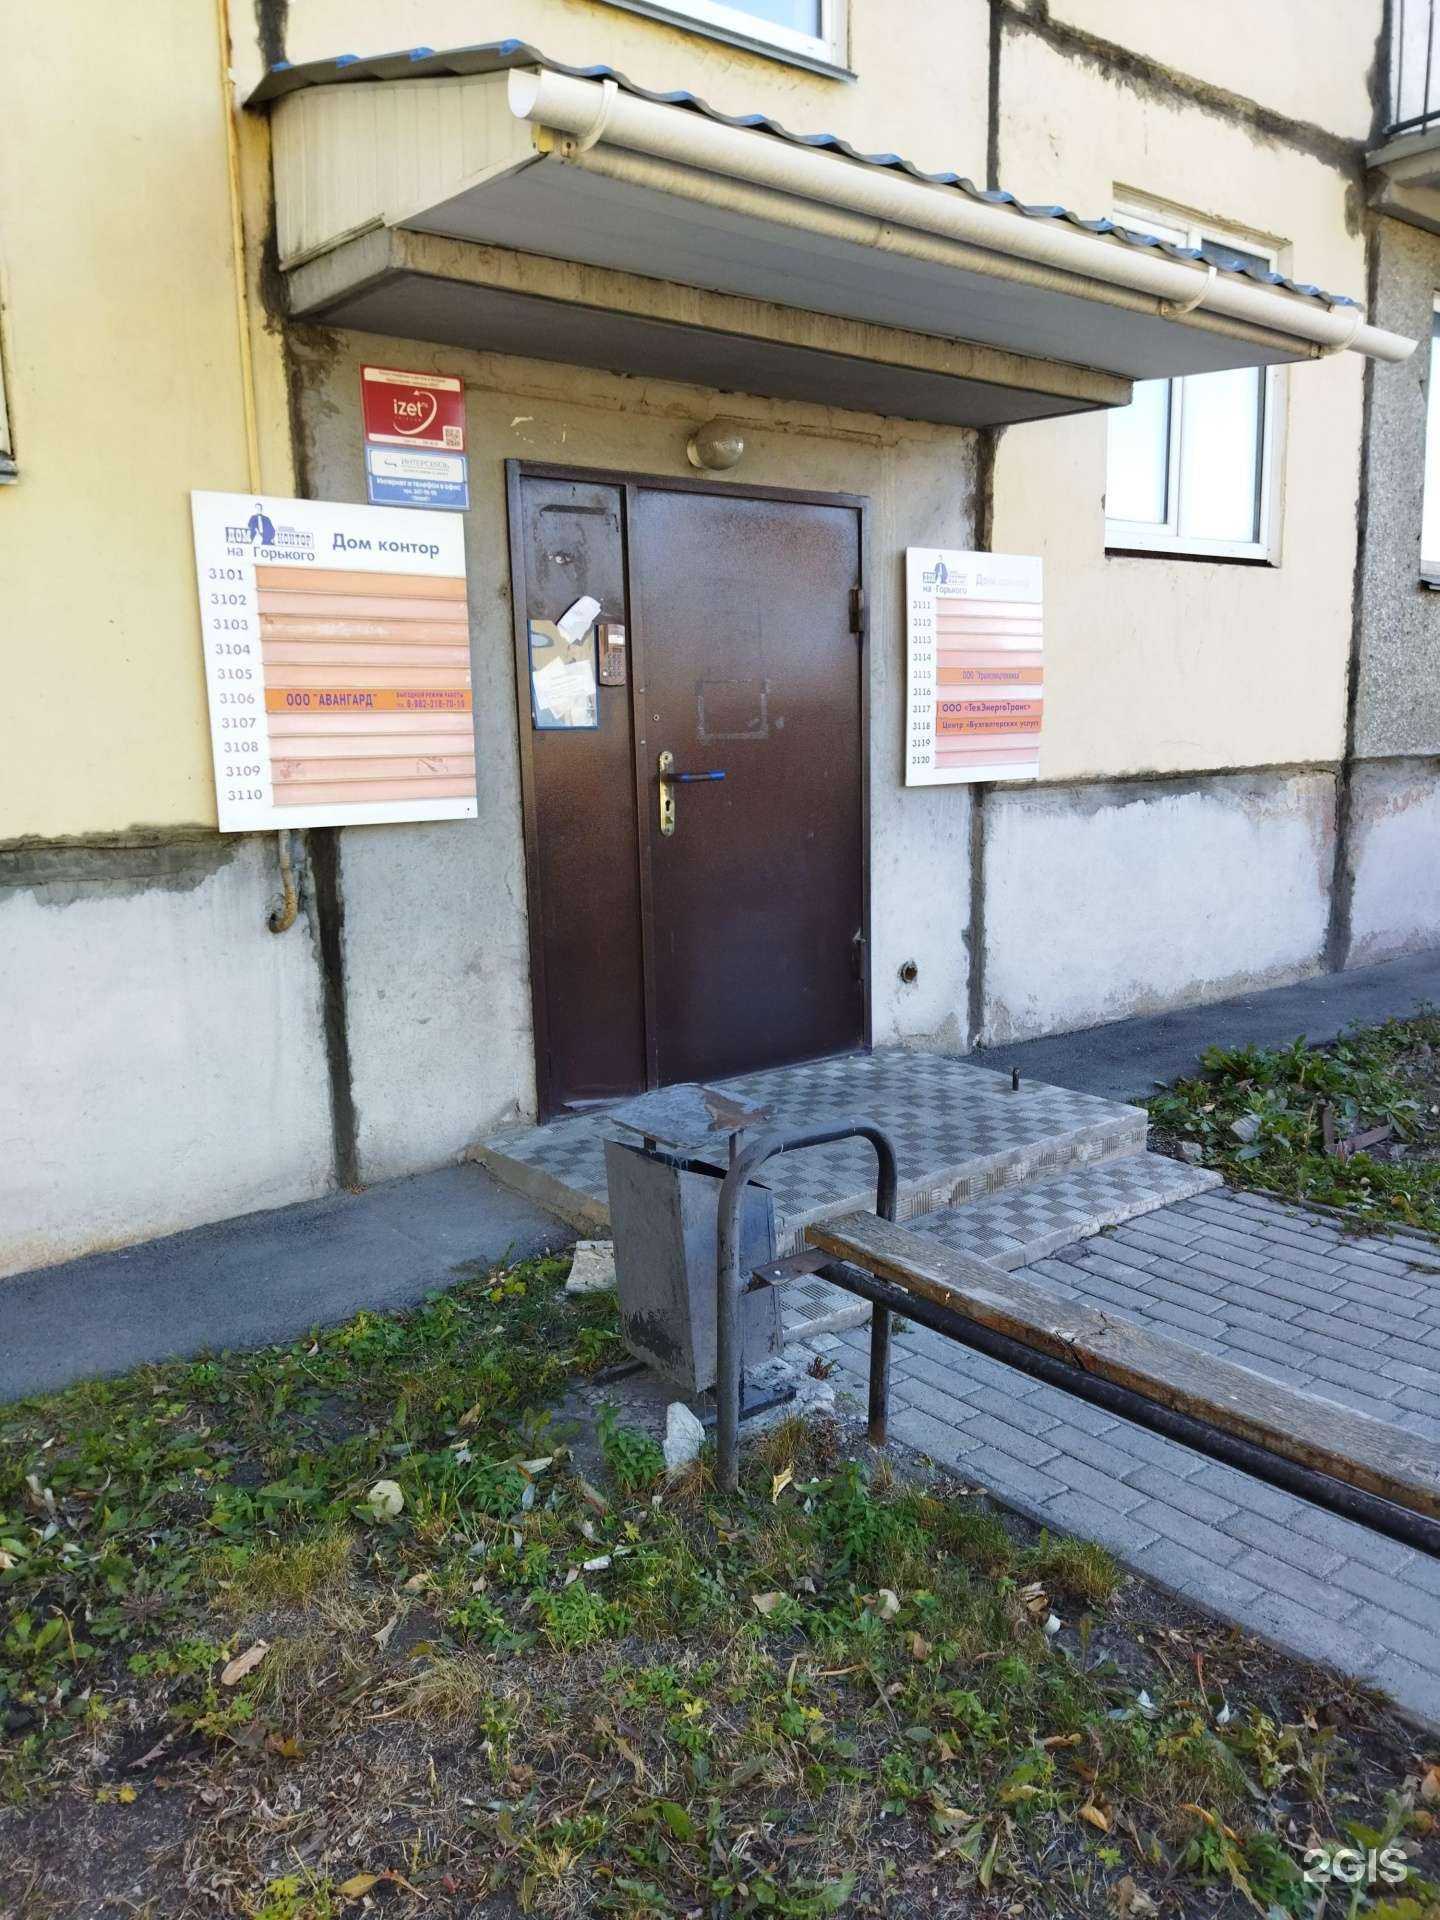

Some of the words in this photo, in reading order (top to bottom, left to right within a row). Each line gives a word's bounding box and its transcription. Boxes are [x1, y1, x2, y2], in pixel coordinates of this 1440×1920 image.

[393, 398, 423, 417] izet
[333, 533, 372, 550] Дом
[379, 541, 440, 560] контор
[227, 547, 244, 557] на
[253, 546, 316, 562] Горького
[208, 568, 243, 580] 3101
[211, 593, 247, 606] 3102
[912, 600, 931, 609] 3111
[213, 618, 249, 631] 3103
[912, 618, 932, 627] 3112
[912, 636, 932, 645] 3113
[215, 643, 251, 655] 3104
[912, 653, 932, 661] 3114
[218, 668, 253, 680] 3105
[913, 670, 932, 679] 3115
[219, 692, 255, 704] 3106
[913, 688, 931, 696] 3116
[286, 693, 310, 706] ООО
[912, 704, 931, 713] 3117
[942, 703, 962, 713] ООО
[221, 717, 256, 729] 3107
[912, 721, 931, 730] 3118
[224, 741, 259, 753] 3108
[912, 738, 931, 747] 3119
[912, 755, 930, 764] 3120
[226, 765, 260, 777] 3109
[228, 789, 263, 801] 3110
